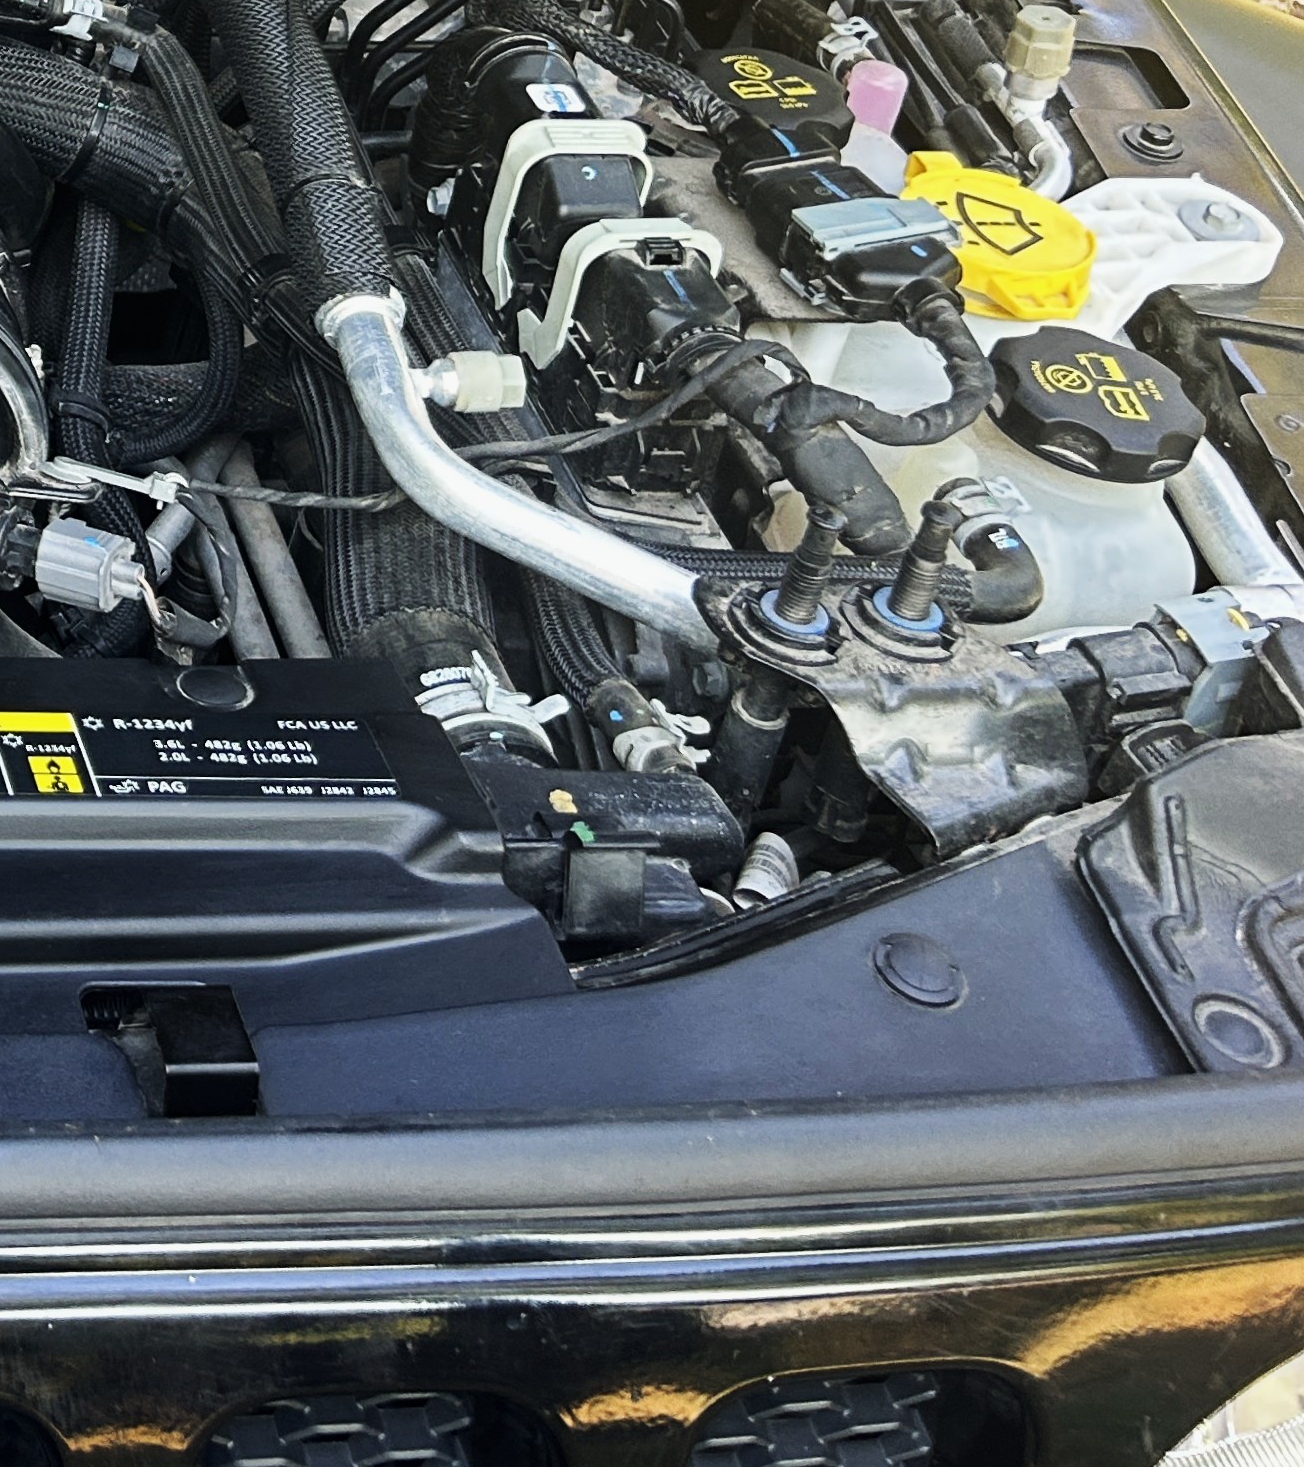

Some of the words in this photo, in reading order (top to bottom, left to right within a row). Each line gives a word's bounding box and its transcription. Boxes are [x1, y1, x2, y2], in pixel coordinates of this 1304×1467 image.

[113, 718, 193, 732] R-1234yf
[277, 720, 308, 731] FCA
[309, 720, 331, 731] US
[332, 720, 359, 731] LLC
[153, 739, 186, 750] 3.6L
[204, 739, 242, 752] 482g
[246, 739, 286, 752] (1.06
[287, 740, 312, 753] Lb)
[158, 751, 191, 763] 2.0L
[209, 752, 248, 765] 482g
[252, 752, 292, 765] (1.06
[293, 753, 318, 766] Lb)
[147, 780, 187, 794] PAG
